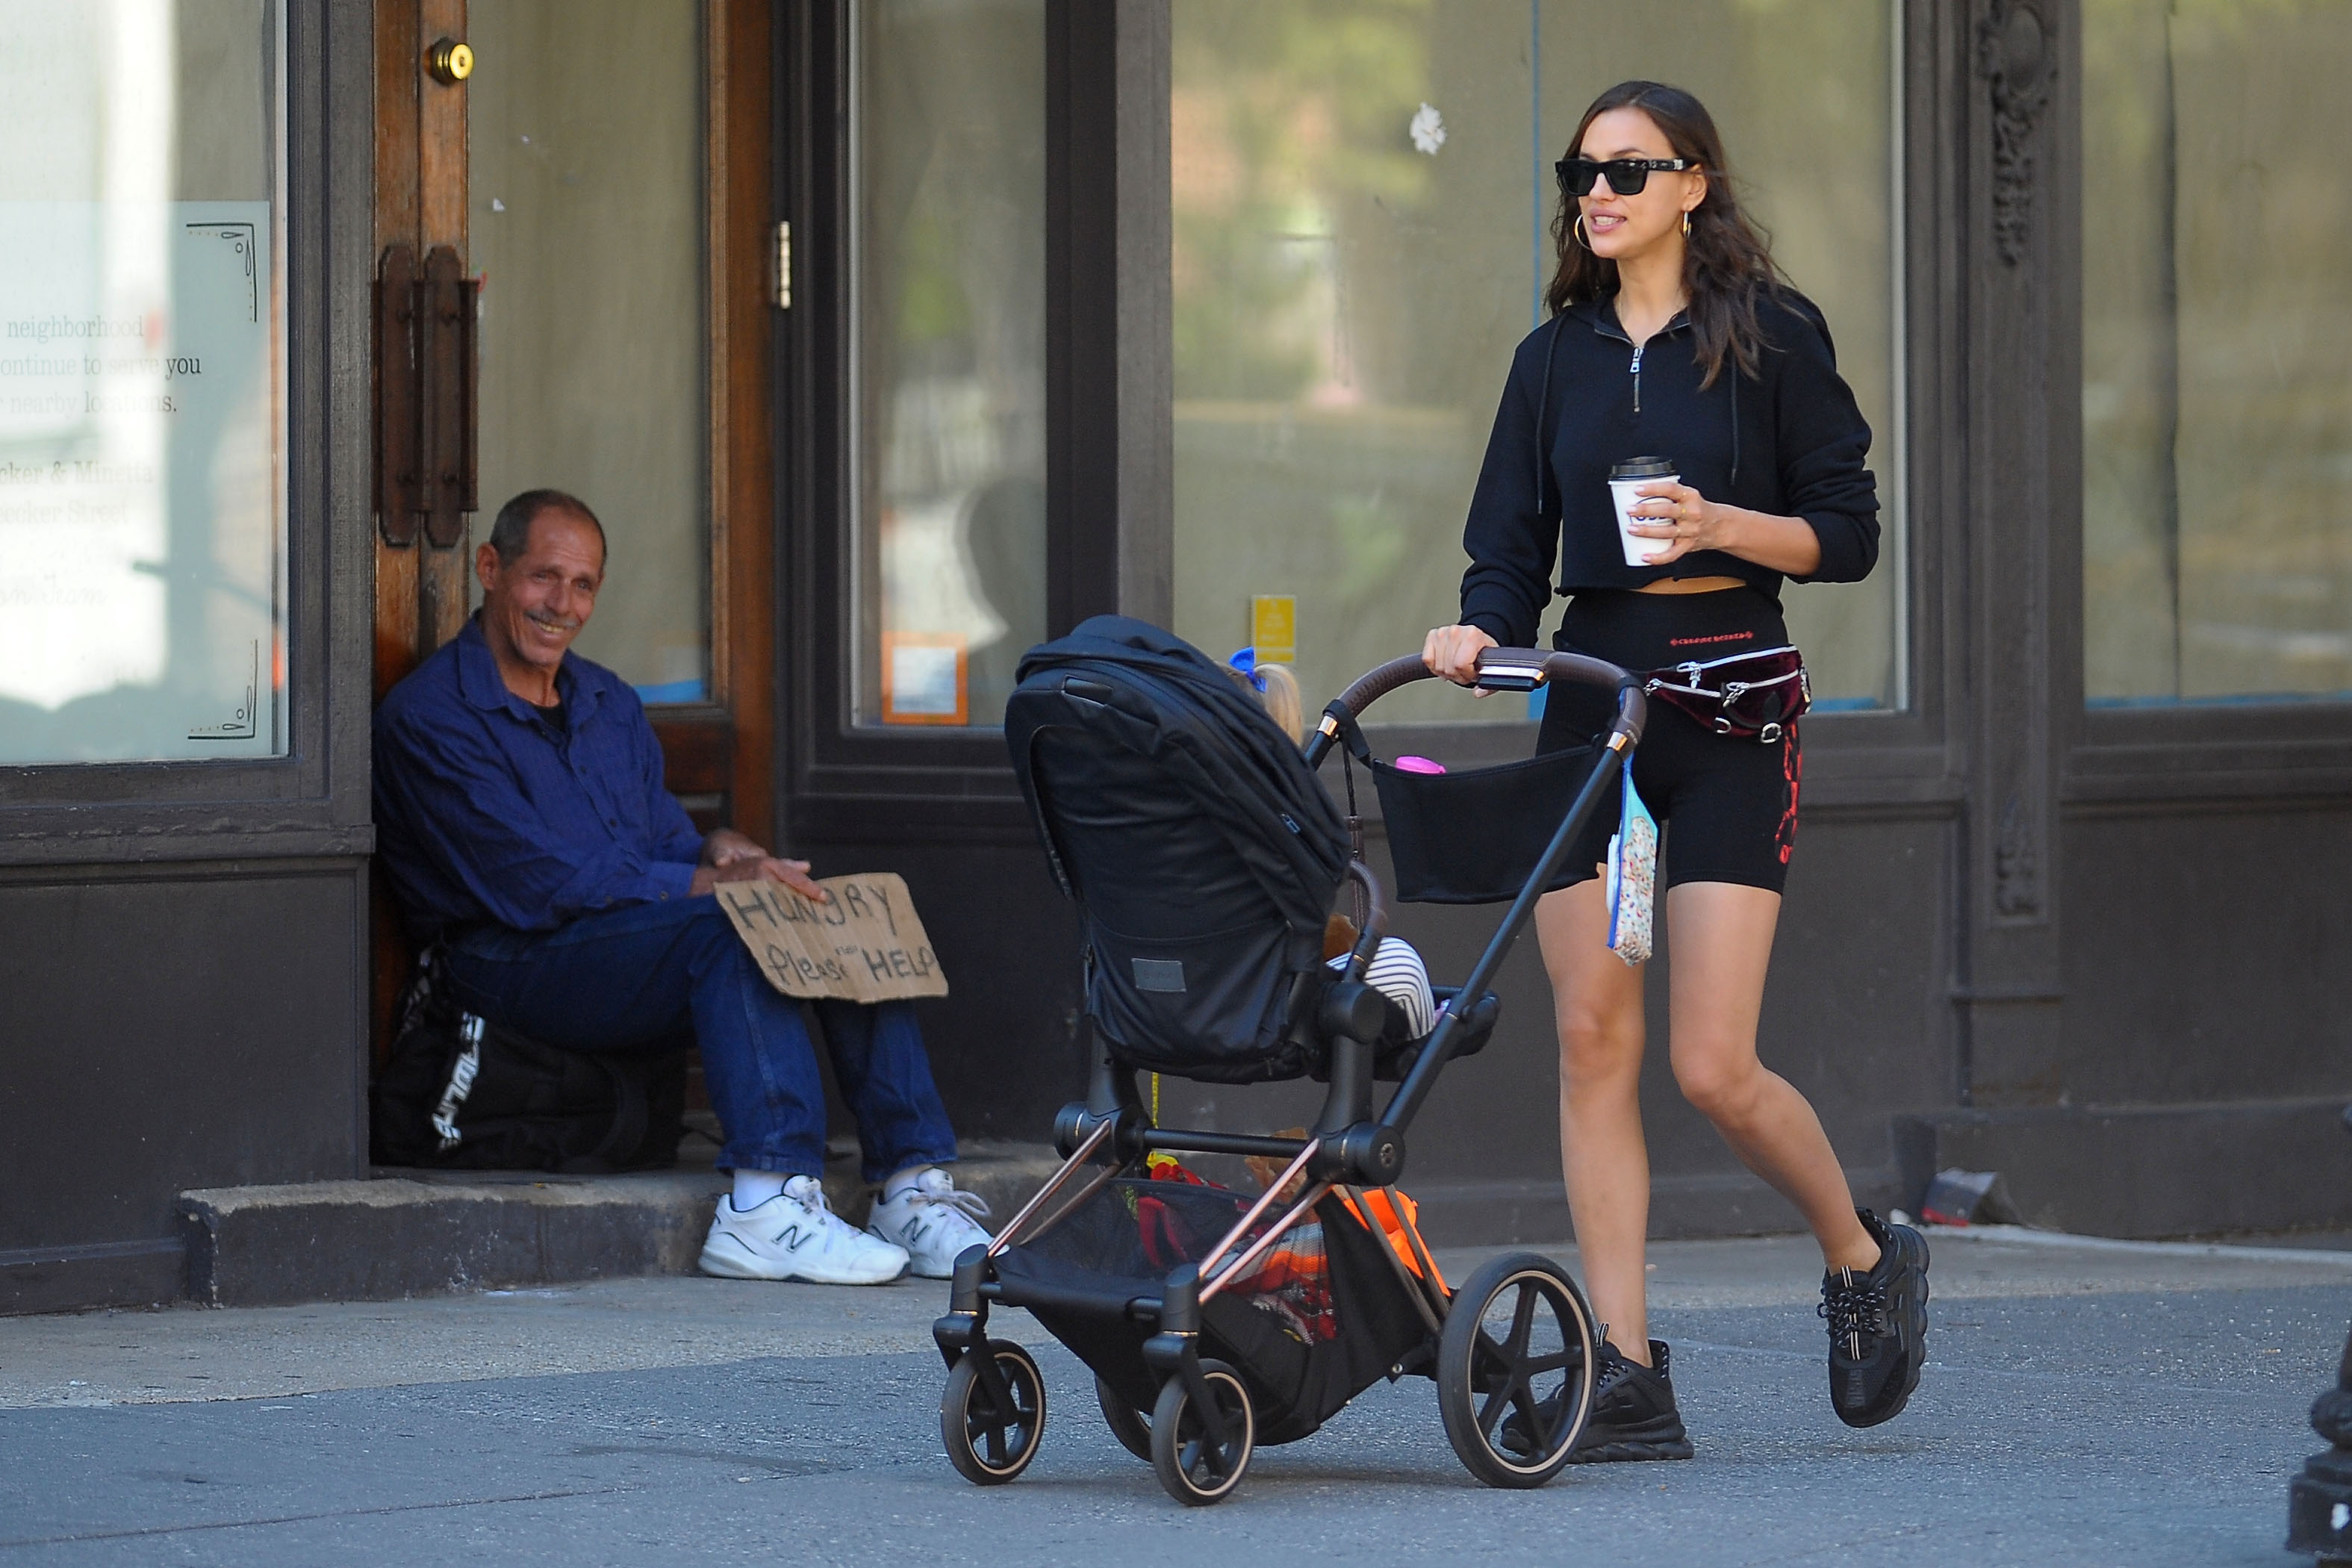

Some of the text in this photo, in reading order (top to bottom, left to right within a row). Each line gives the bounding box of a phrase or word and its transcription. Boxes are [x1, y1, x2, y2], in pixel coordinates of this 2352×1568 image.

[7, 315, 144, 344] neighborhood
[84, 352, 102, 375] to
[108, 358, 159, 376] serve
[165, 357, 202, 381] you
[11, 389, 78, 418] nearby
[50, 460, 66, 484] &
[862, 946, 936, 982] HELP
